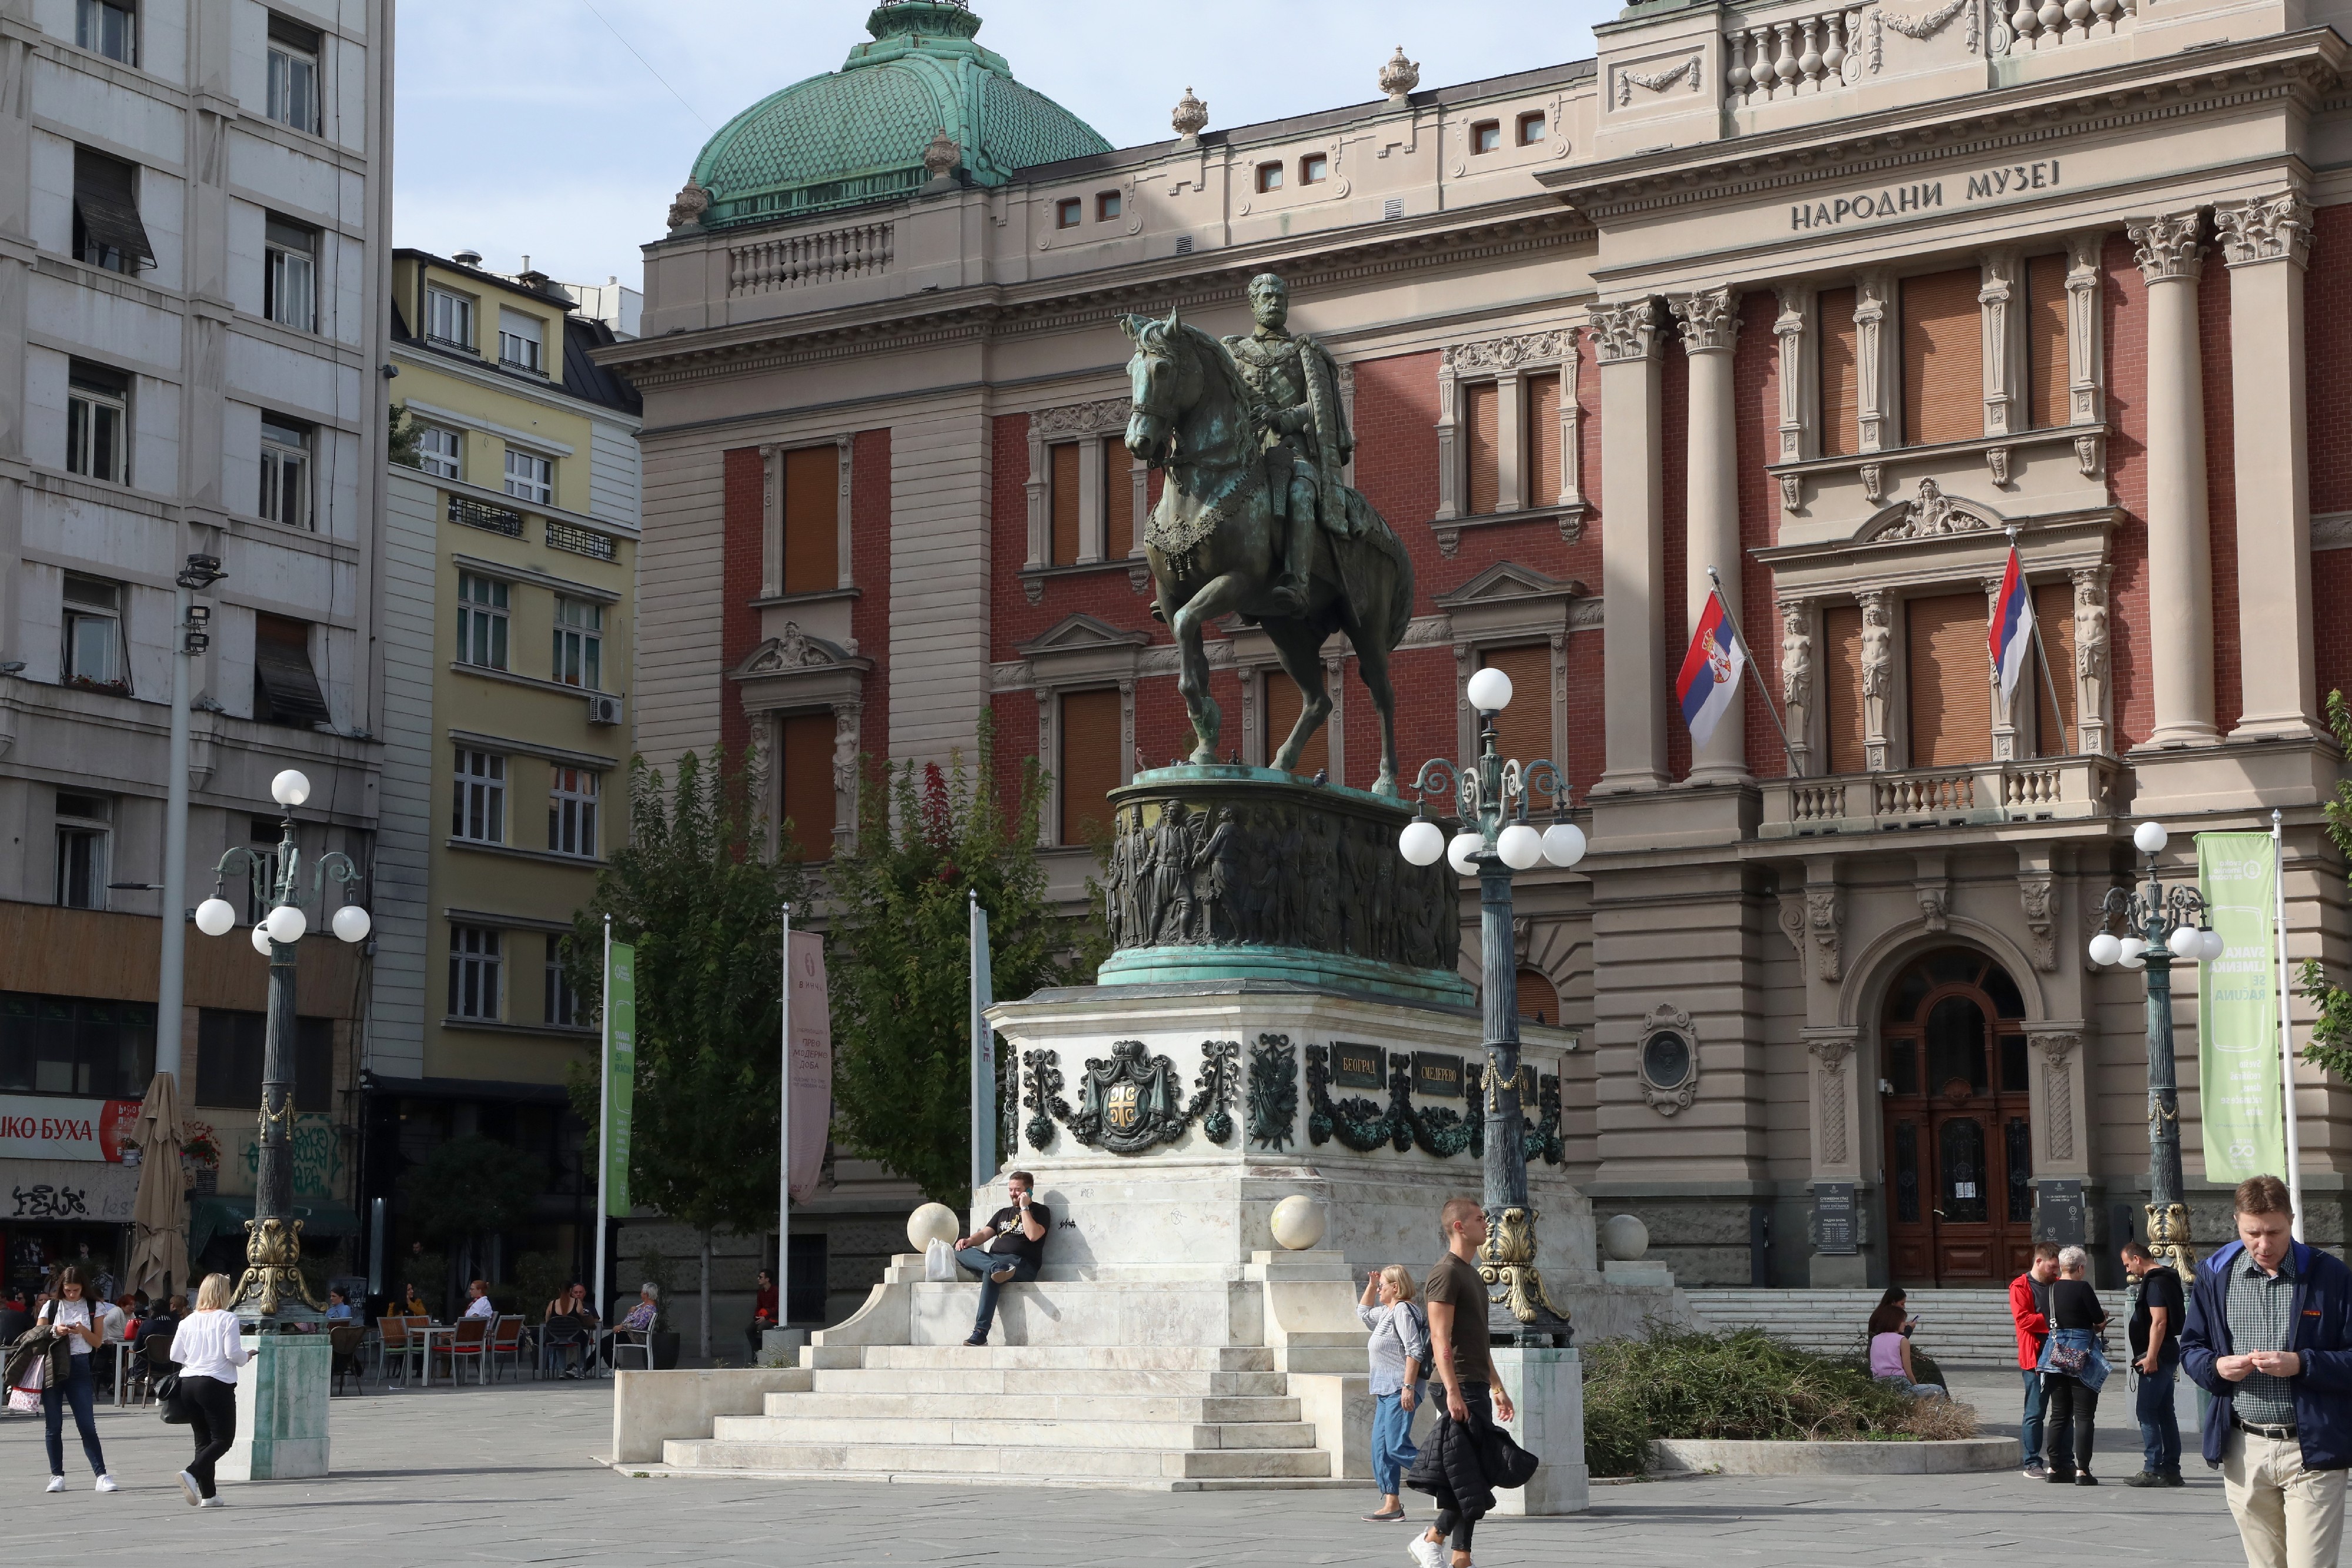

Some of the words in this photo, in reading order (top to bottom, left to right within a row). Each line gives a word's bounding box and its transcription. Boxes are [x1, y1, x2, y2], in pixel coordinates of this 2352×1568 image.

[1791, 182, 1943, 230] НАРОДНИ
[1966, 159, 2060, 200] МУЗЕЈ
[802, 1038, 821, 1047] ПРВО
[793, 1049, 828, 1059] МОДЕРНО
[799, 1060, 819, 1069] ДОБА
[1342, 1057, 1376, 1075] БЕОГРАД
[1421, 1065, 1457, 1082] СМЕДЕРЕВО
[41, 1118, 92, 1141] БУХА
